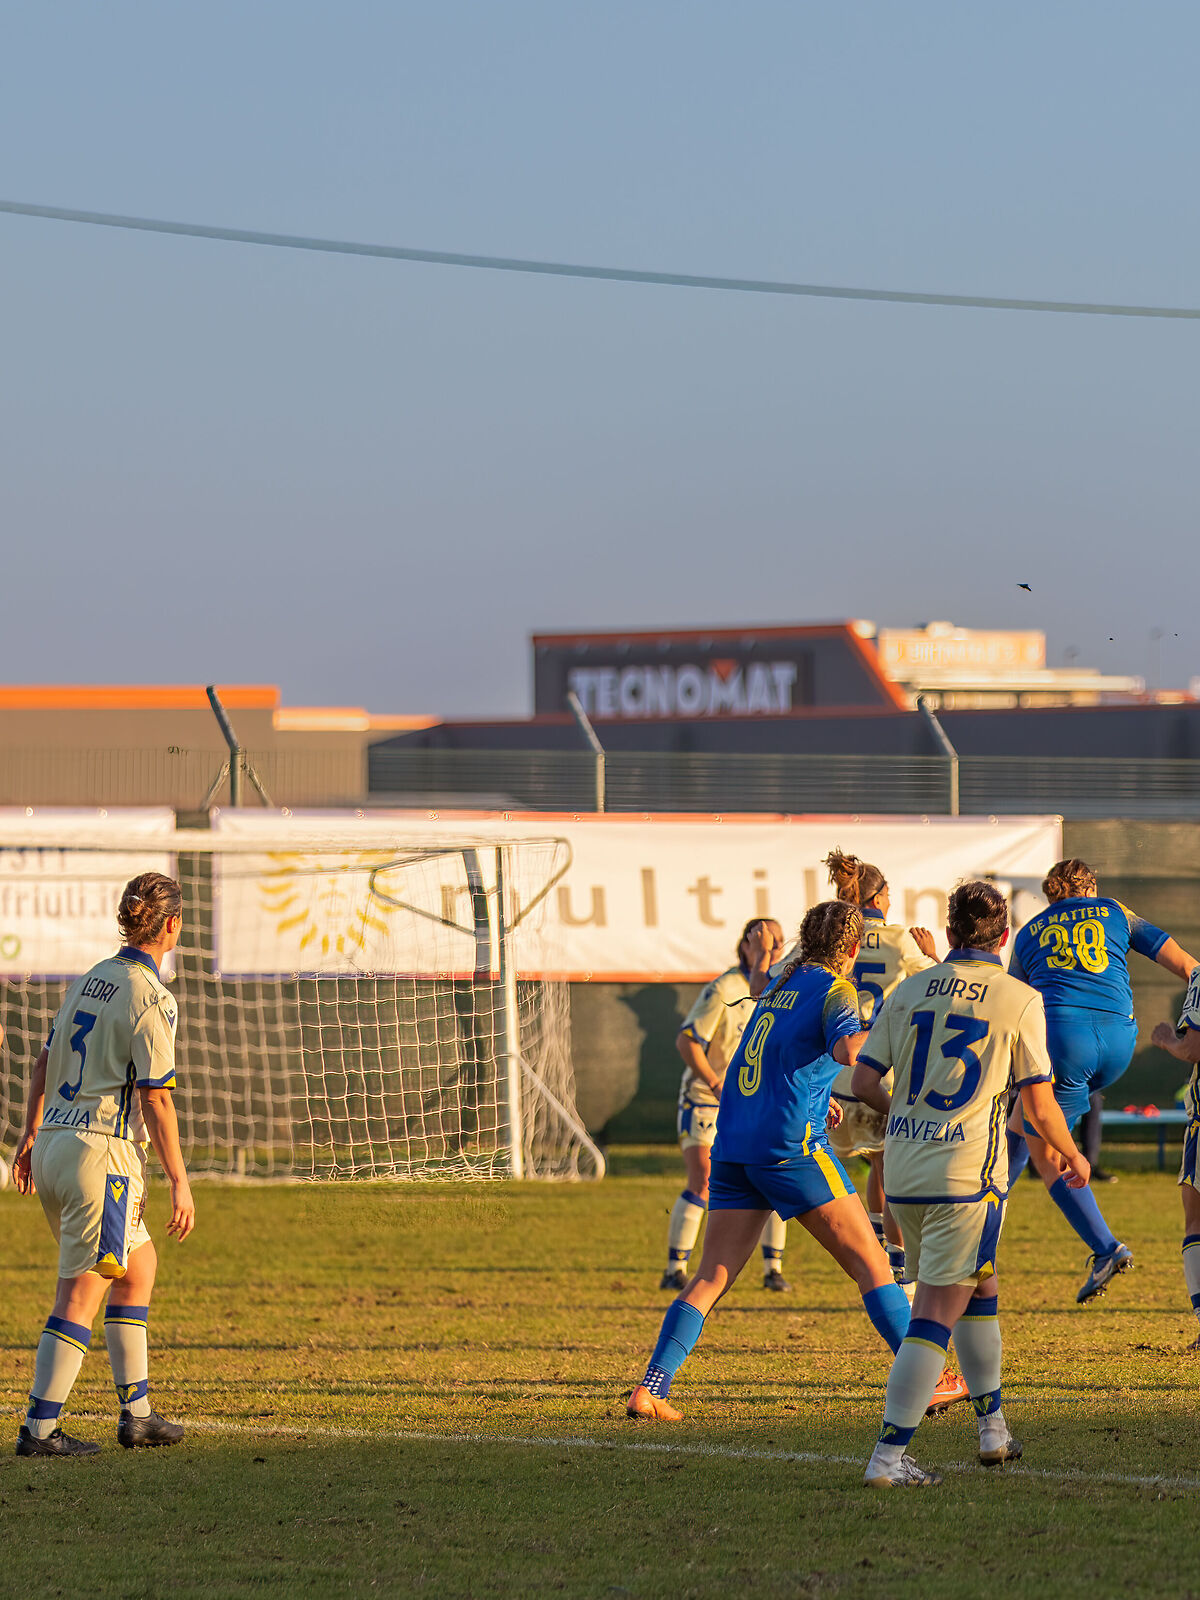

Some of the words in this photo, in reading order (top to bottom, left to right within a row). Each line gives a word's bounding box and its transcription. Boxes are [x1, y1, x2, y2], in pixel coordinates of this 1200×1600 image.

[568, 660, 796, 718] TECNOMAT
[1029, 919, 1045, 937] DE
[1048, 906, 1110, 925] MATTEIS
[1039, 918, 1110, 974] 38
[80, 976, 120, 1004] LEDRI
[925, 977, 989, 1003] BURSI
[58, 1009, 97, 1102] 3
[738, 1011, 775, 1097] 9
[909, 1010, 990, 1112] 13
[886, 1113, 966, 1143] NAVELIA
